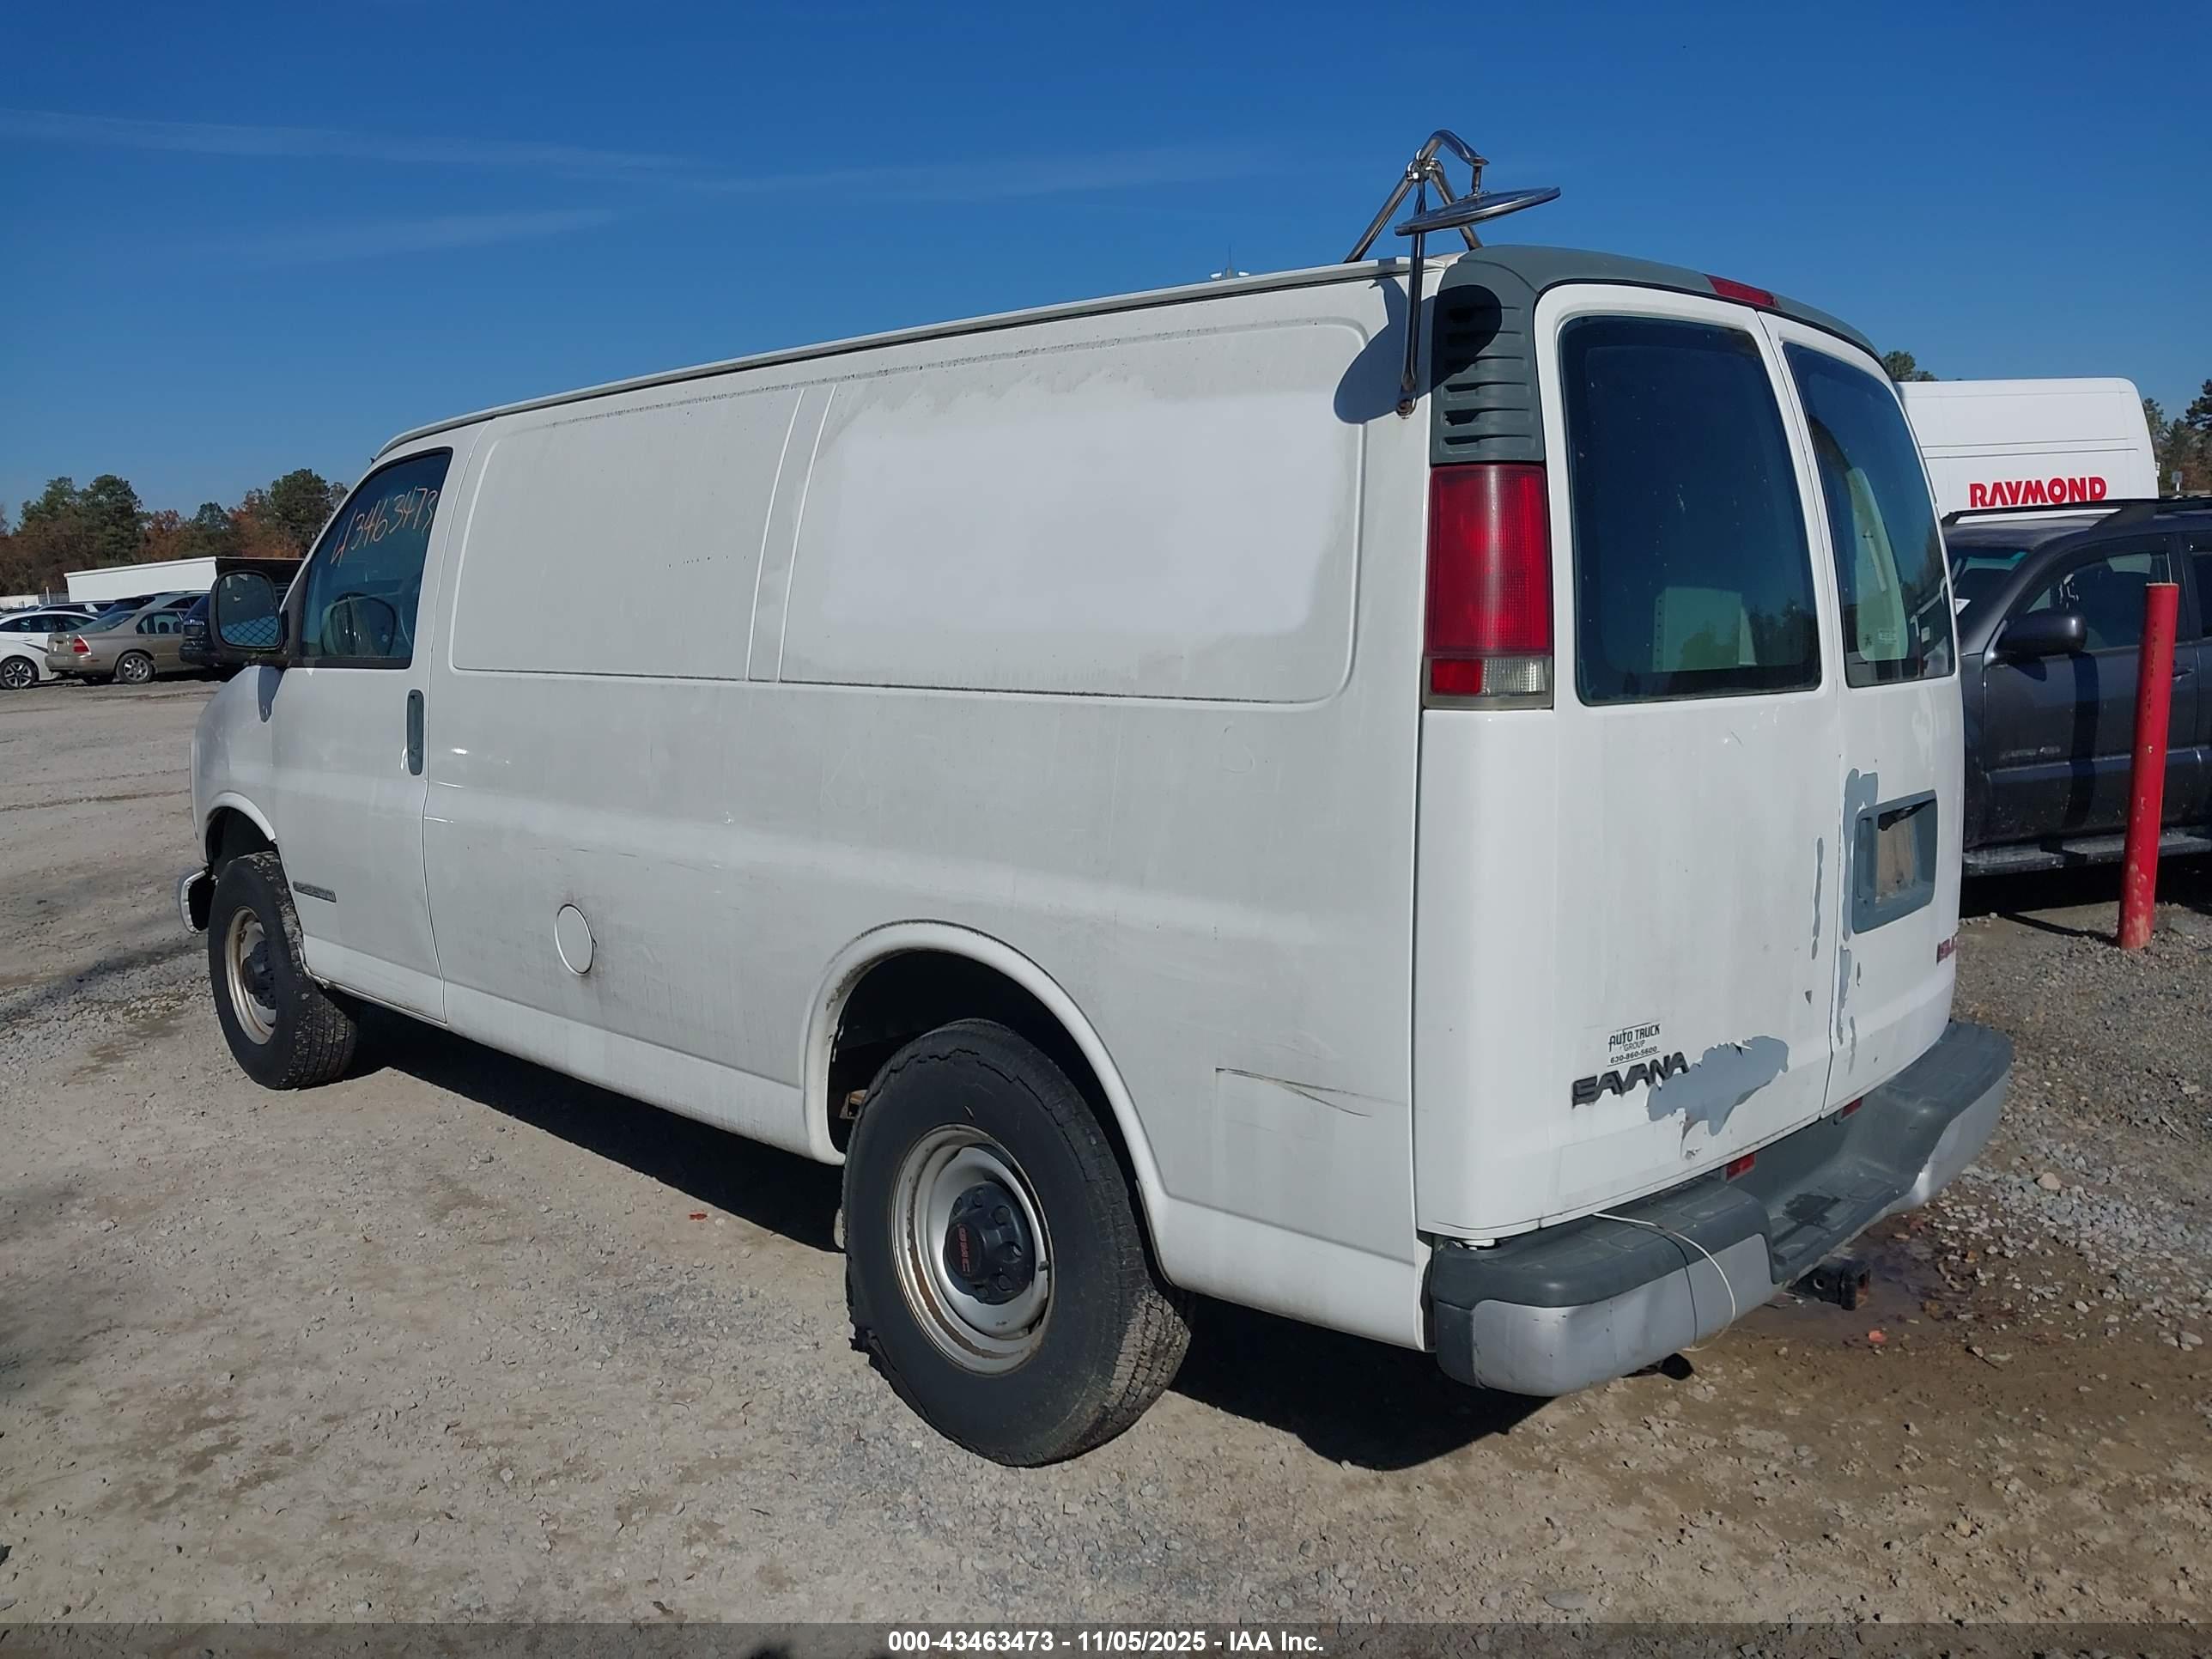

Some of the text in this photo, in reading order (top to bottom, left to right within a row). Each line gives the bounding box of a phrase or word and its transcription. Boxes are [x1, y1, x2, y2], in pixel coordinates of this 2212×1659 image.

[1969, 476, 2107, 508] RAYMOND
[1608, 1024, 1661, 1053] AUTO TRUCK
[1624, 1040, 1646, 1052] GROUP
[1571, 1051, 1690, 1109] SAVANA
